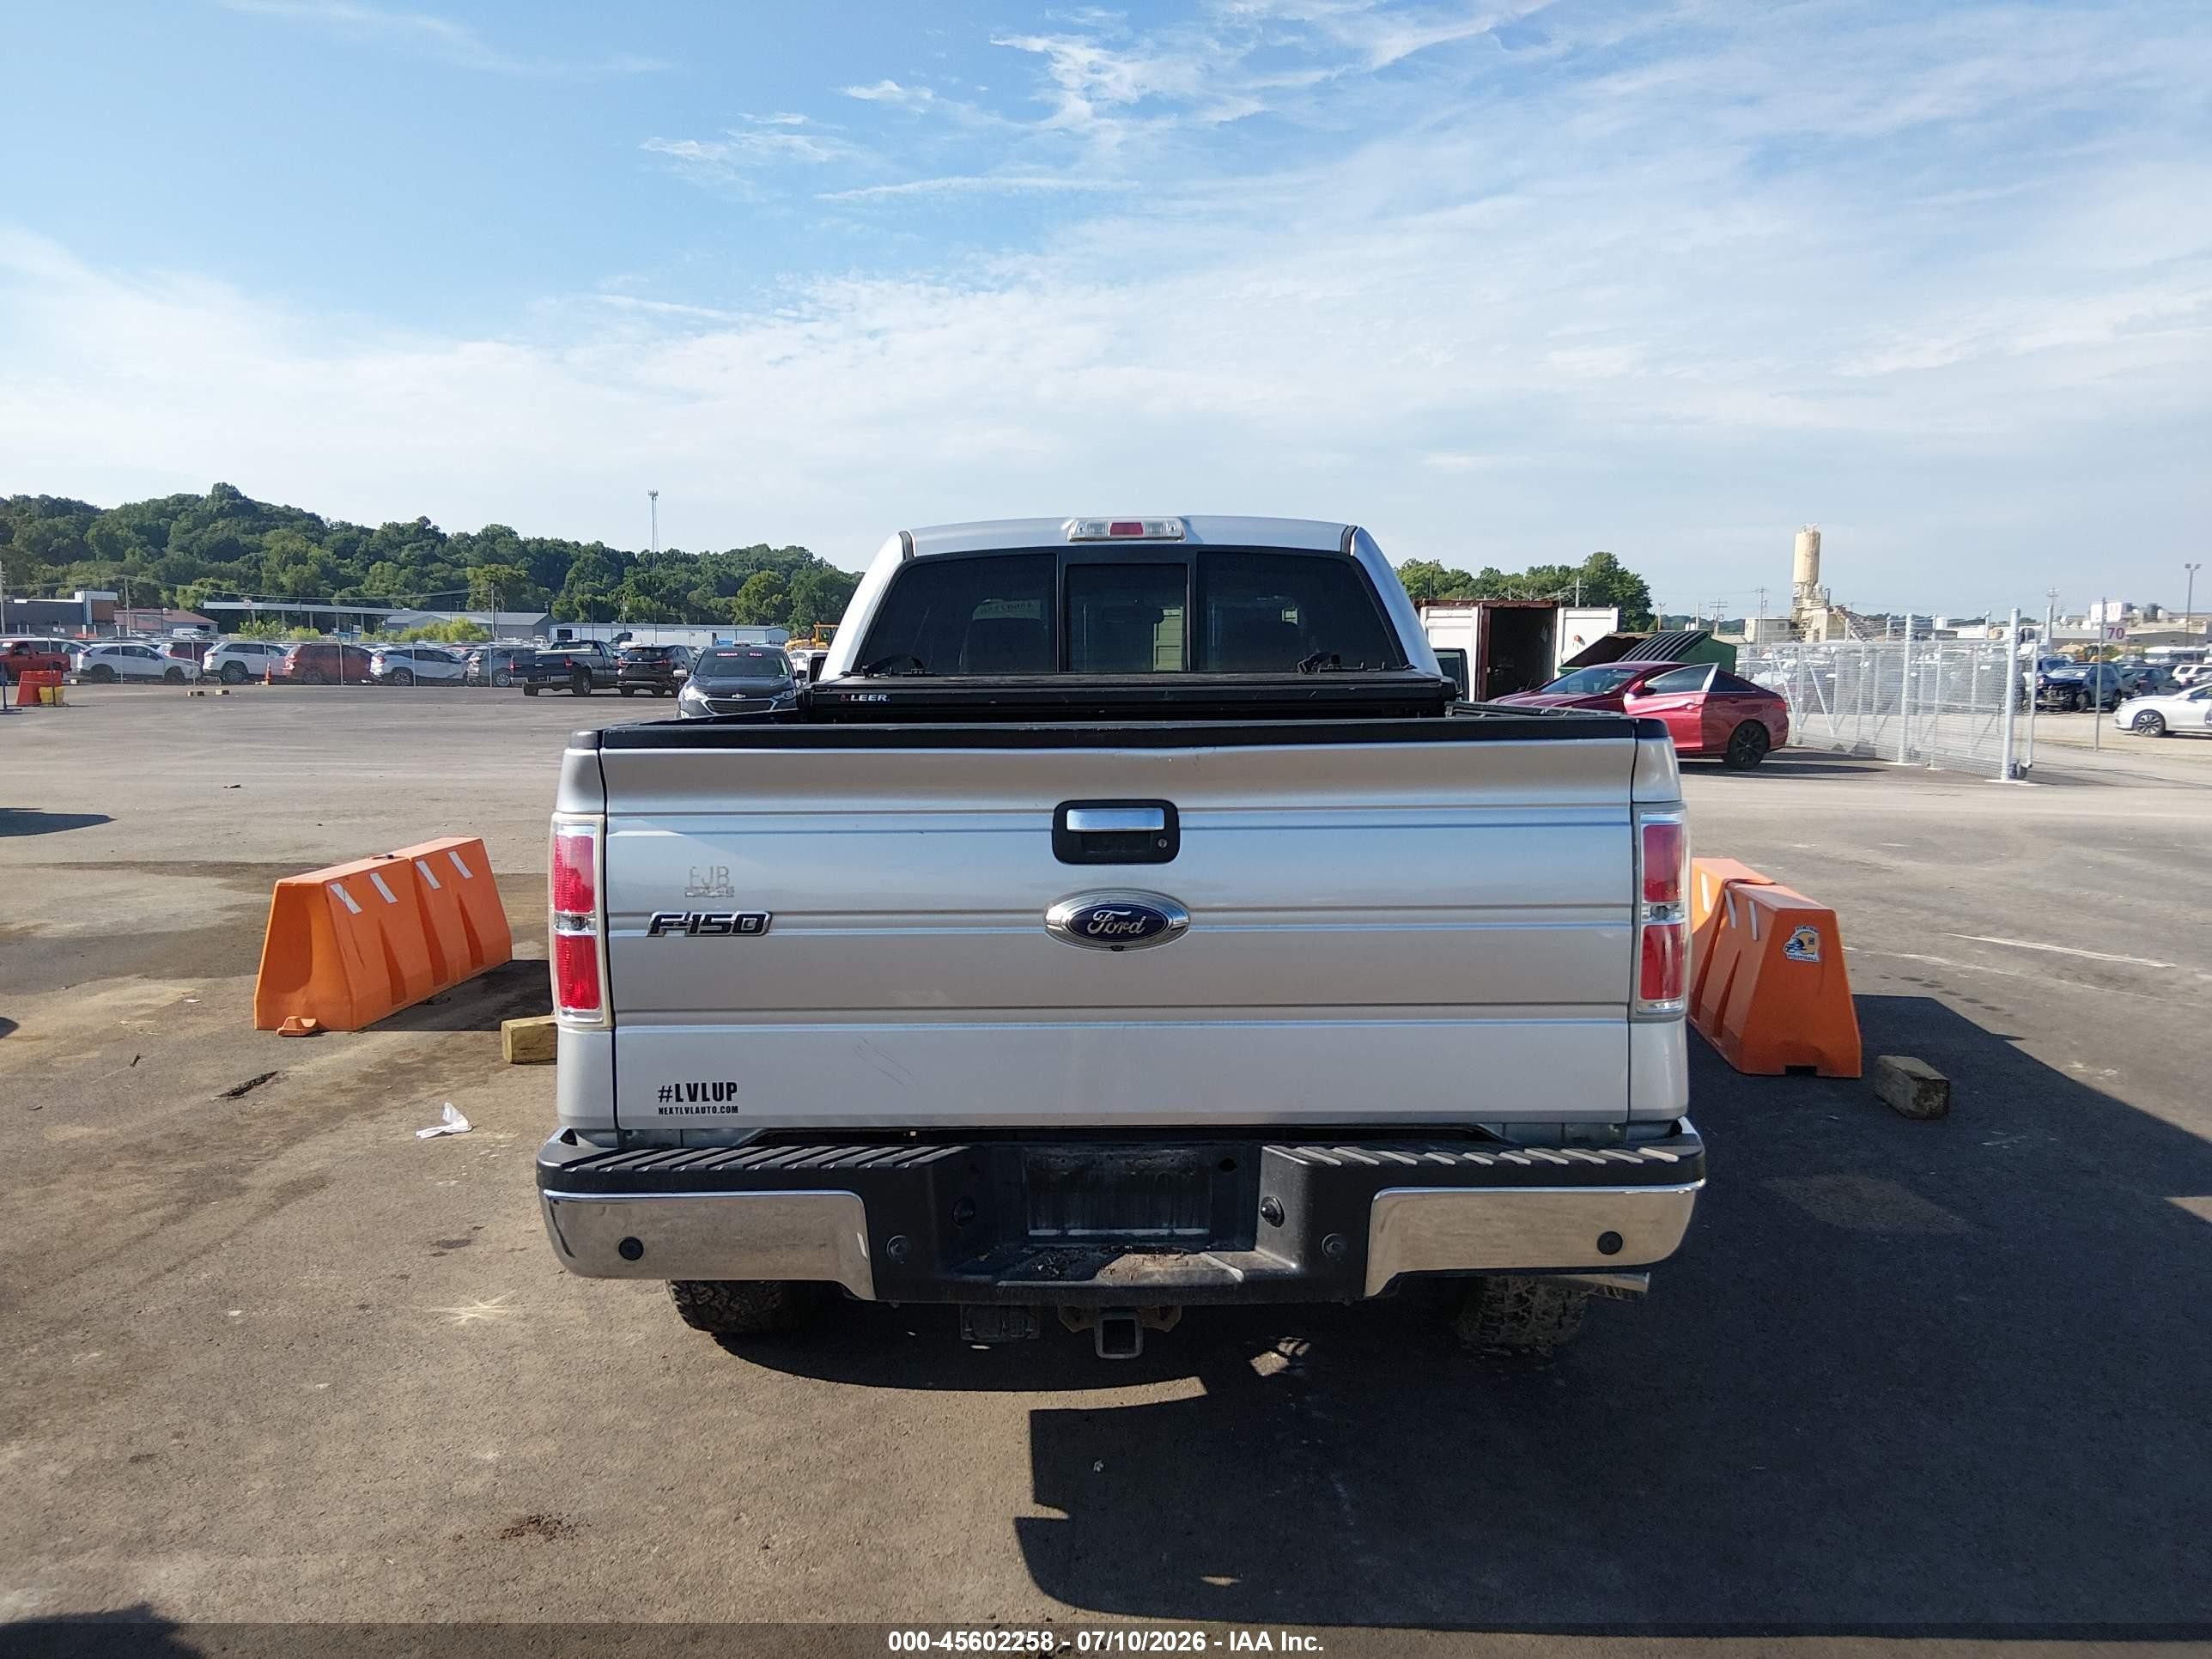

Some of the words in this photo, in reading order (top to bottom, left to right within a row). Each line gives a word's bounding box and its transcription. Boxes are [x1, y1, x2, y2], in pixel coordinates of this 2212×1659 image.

[2106, 627, 2125, 640] 70
[646, 910, 772, 937] F-150
[1086, 909, 1147, 934] Ford
[657, 1082, 738, 1103] #LVLUP
[658, 1105, 738, 1115] NEXTLVLAUTO.COM
